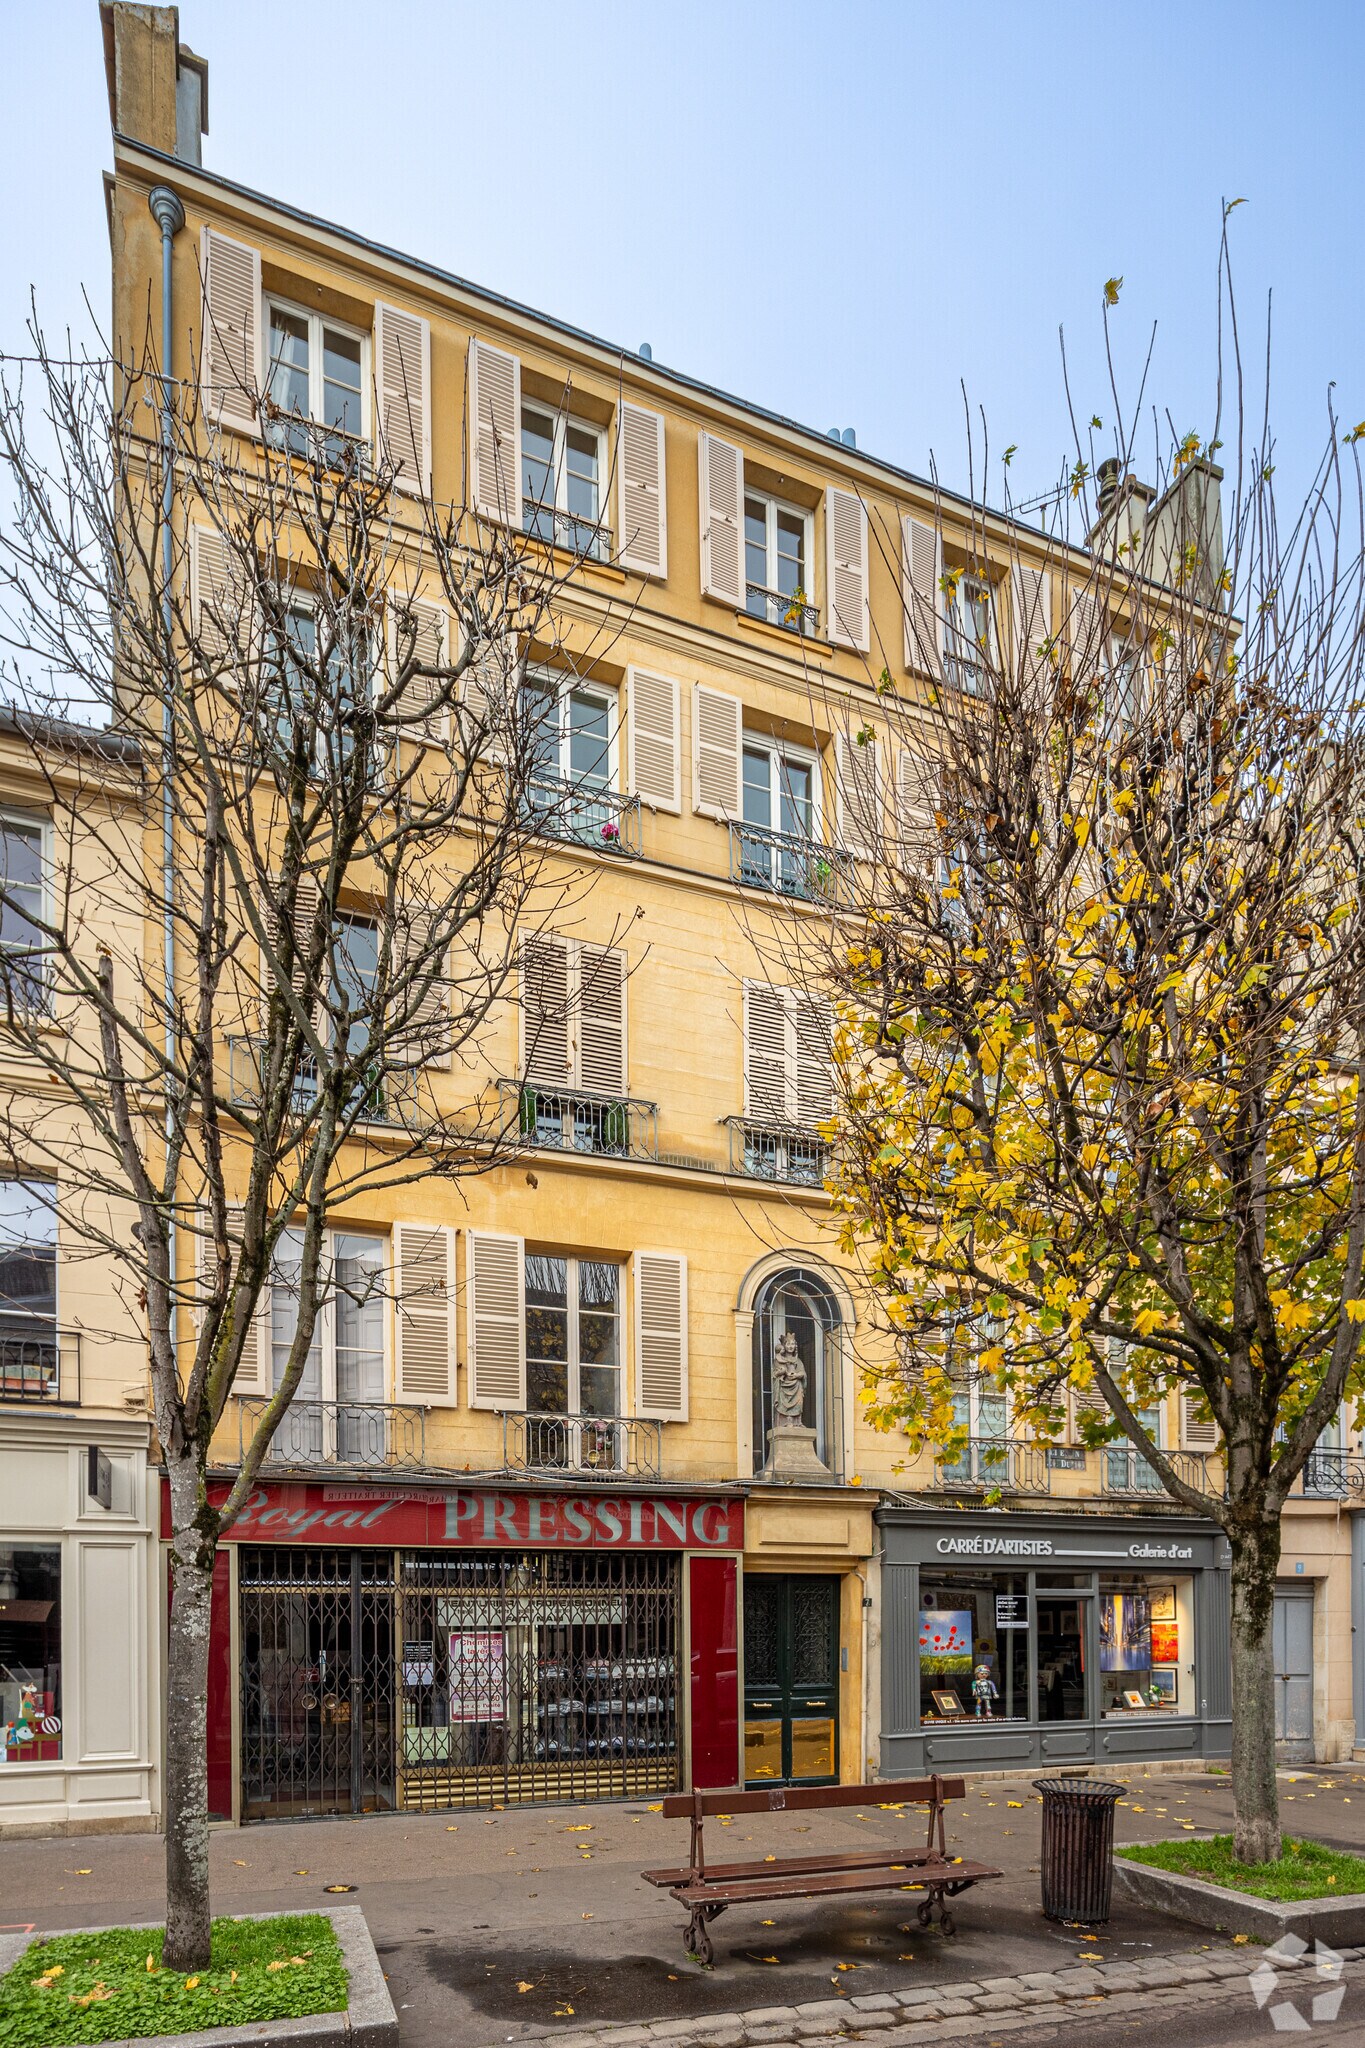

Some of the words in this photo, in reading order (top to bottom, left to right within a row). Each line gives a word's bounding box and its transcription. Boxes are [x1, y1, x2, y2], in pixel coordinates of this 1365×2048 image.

[441, 1494, 731, 1545] PRESSING
[937, 1536, 981, 1554] CARRÉ
[983, 1538, 1053, 1556] D'ARTISTES
[1128, 1544, 1167, 1558] Galerie
[1168, 1545, 1193, 1559] d'art
